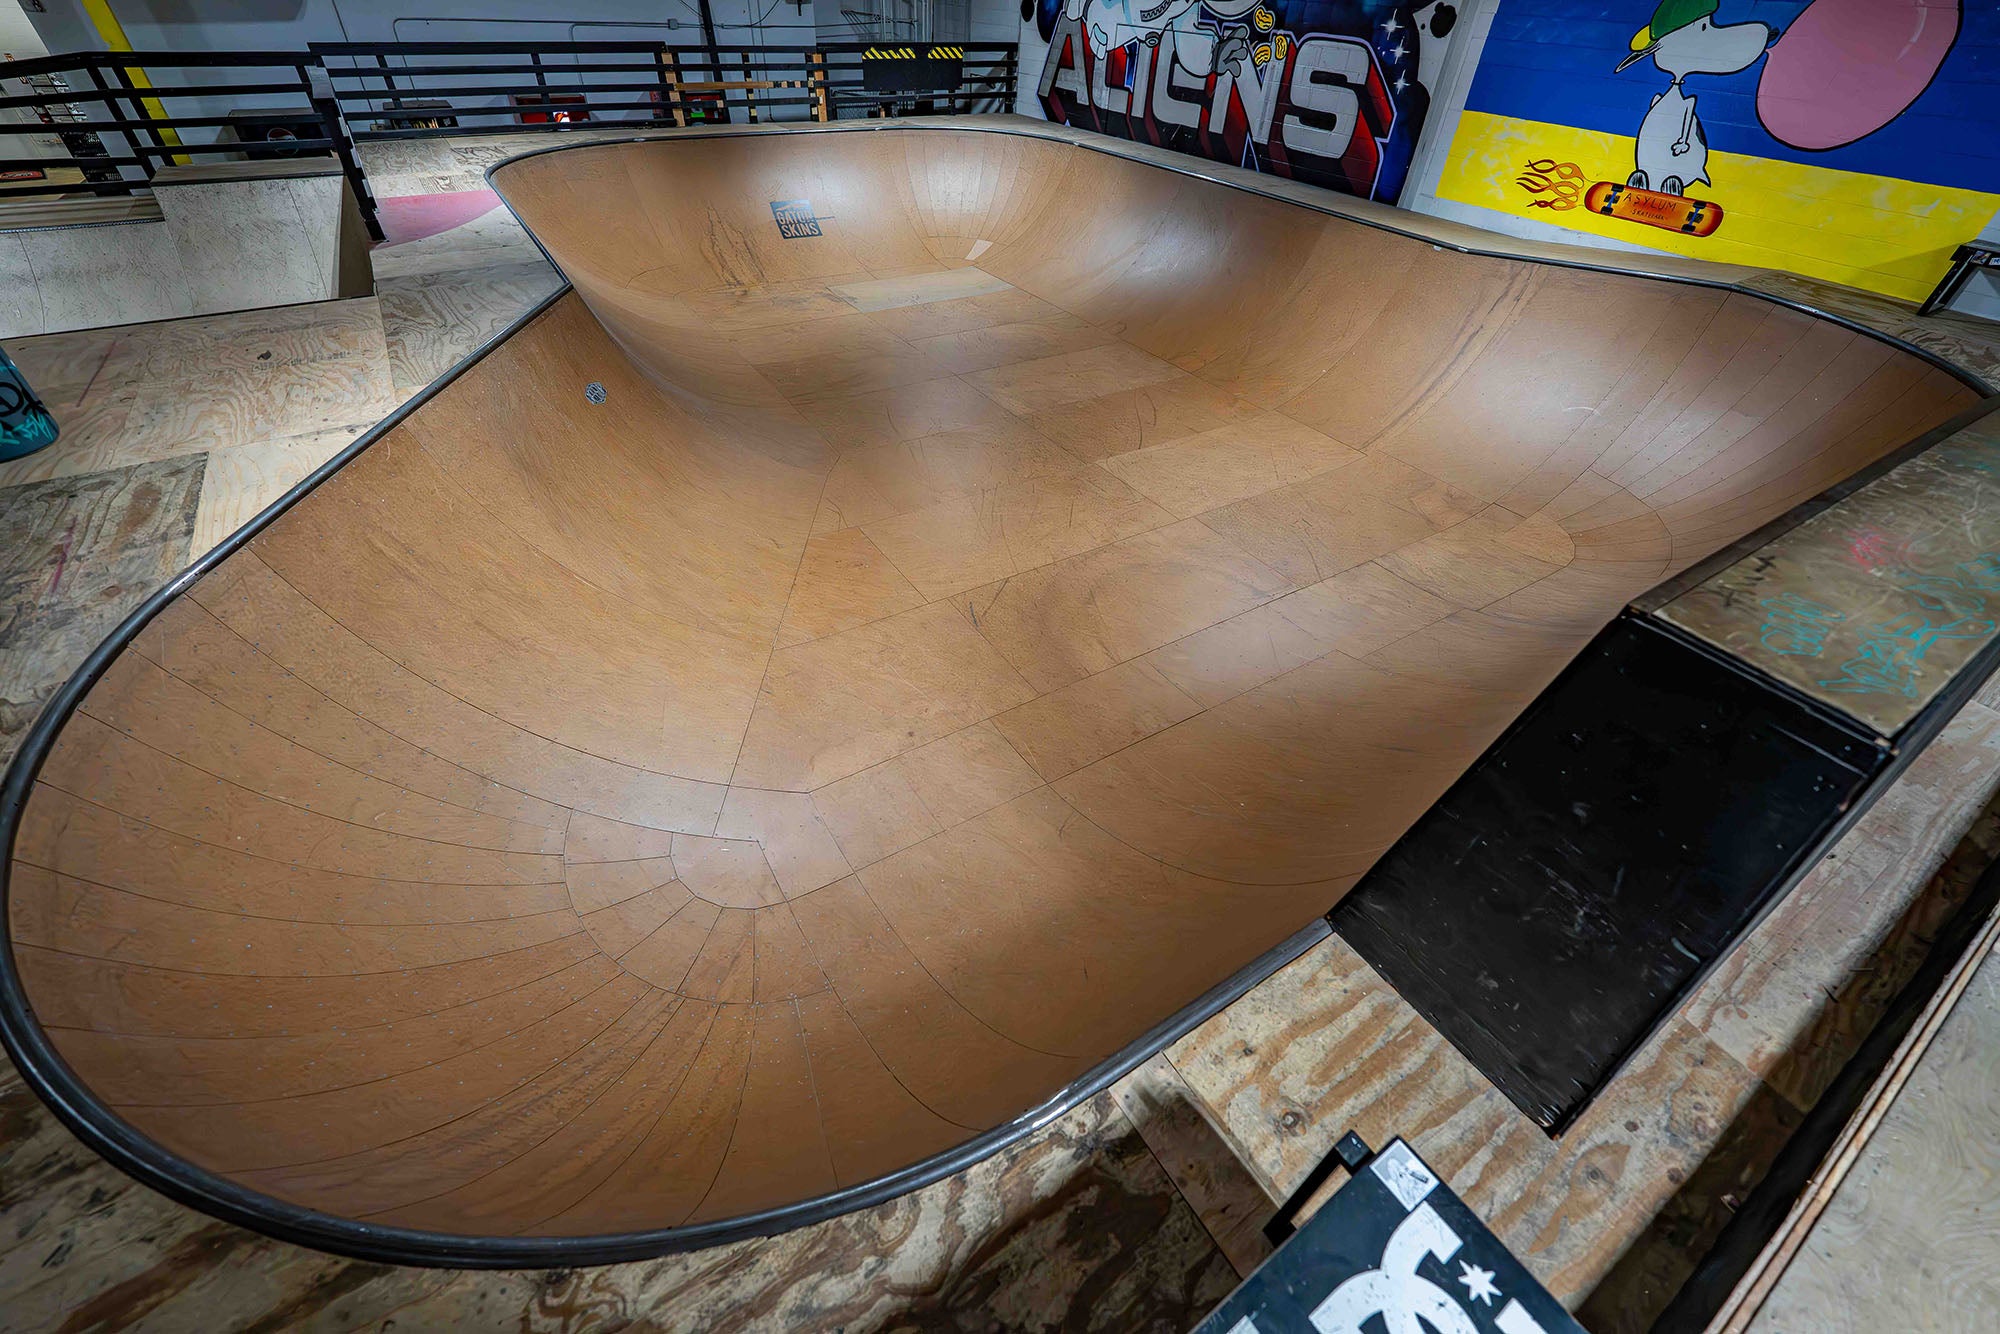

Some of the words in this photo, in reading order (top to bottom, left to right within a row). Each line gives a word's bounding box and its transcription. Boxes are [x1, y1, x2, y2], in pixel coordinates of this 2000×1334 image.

[1037, 12, 1380, 166] ALIENS
[1623, 192, 1677, 211] ASYLUM
[781, 222, 819, 237] SKINS
